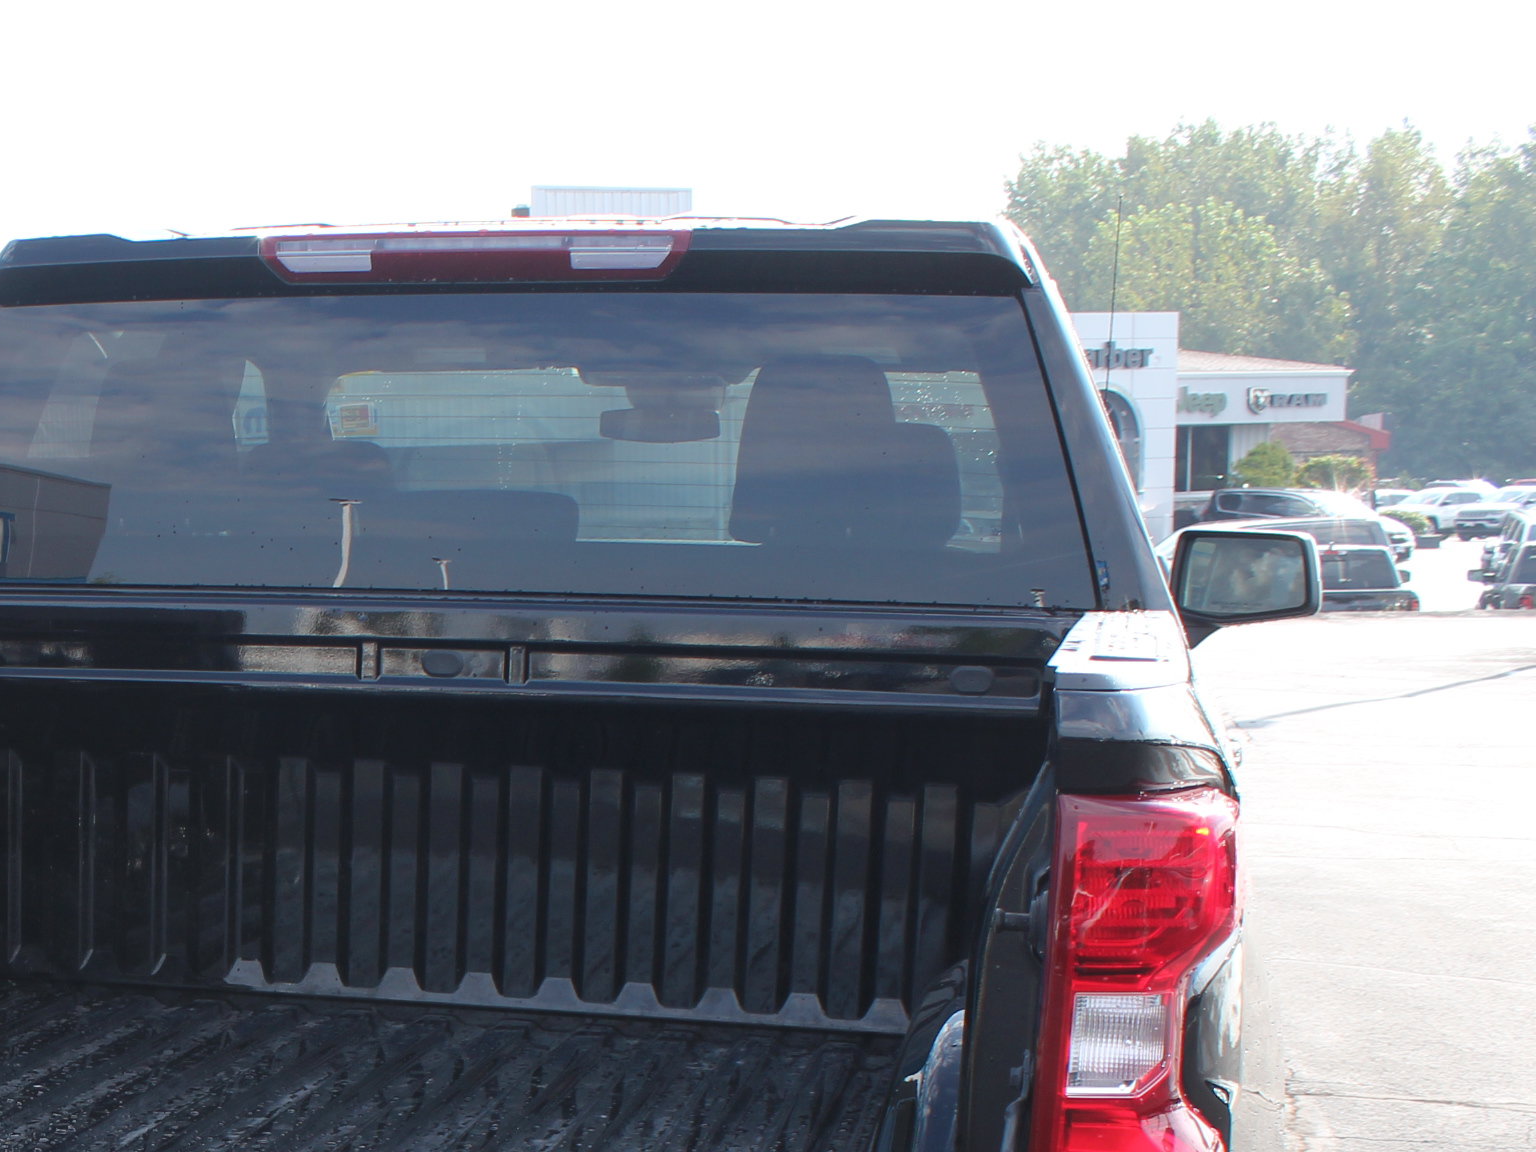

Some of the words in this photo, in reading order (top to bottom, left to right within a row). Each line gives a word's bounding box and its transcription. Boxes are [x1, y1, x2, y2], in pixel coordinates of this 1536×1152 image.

[1084, 341, 1154, 369] arber
[1177, 386, 1227, 417] Jeep
[1269, 392, 1328, 407] RAM
